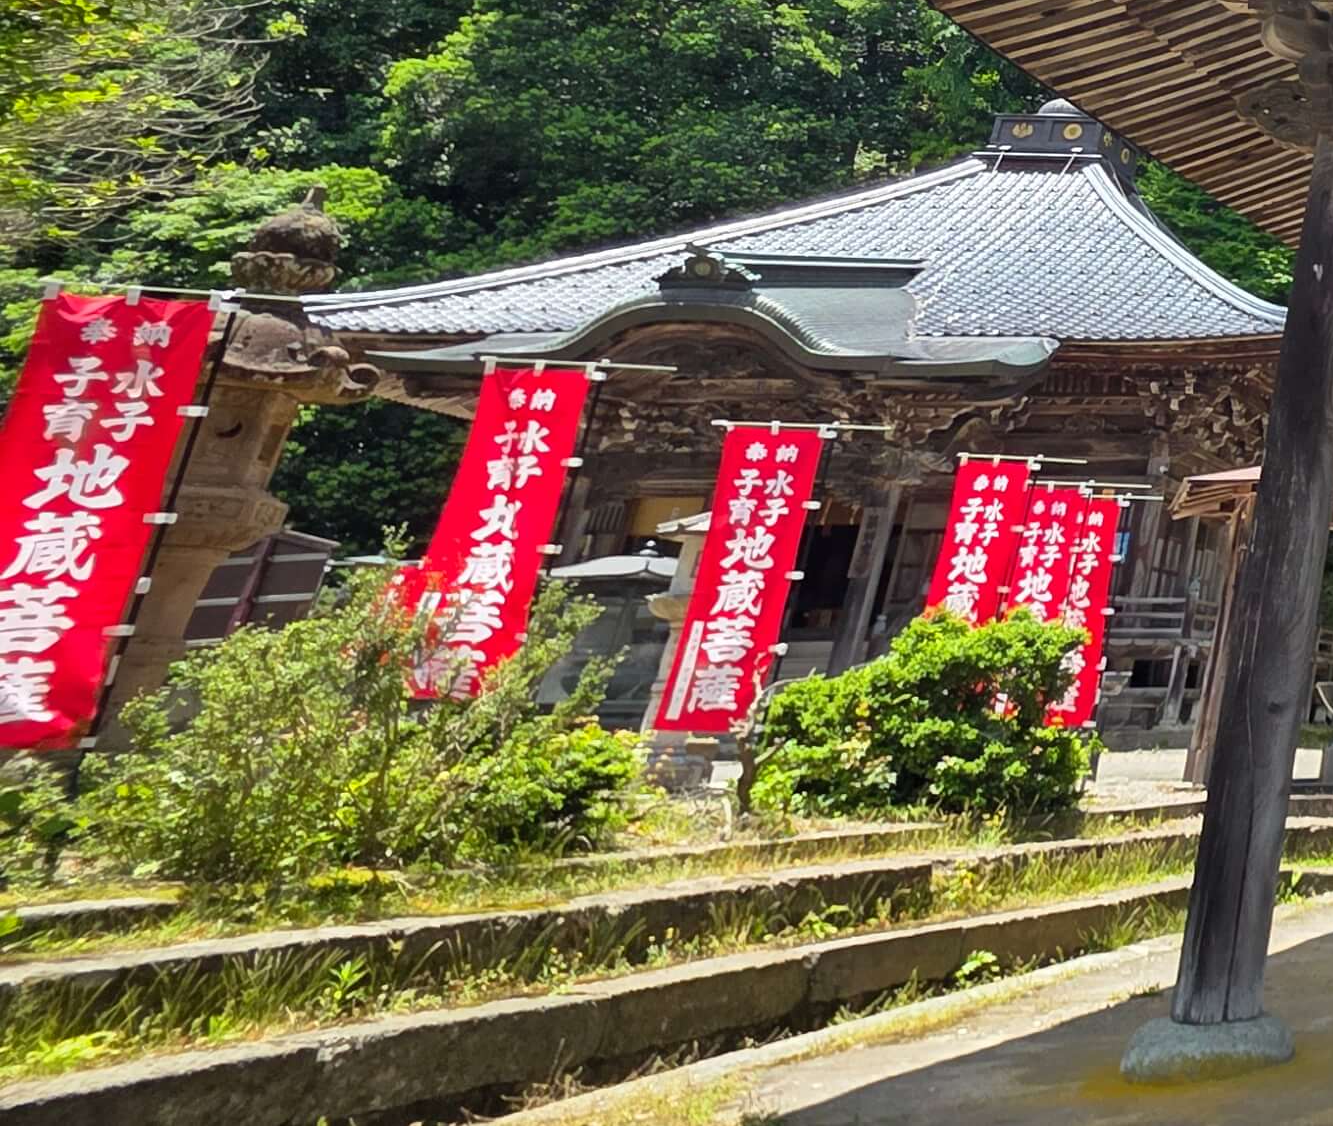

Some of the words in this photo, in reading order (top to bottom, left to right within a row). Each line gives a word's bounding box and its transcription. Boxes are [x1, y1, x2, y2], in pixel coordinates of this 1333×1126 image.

[80, 318, 174, 349] 奉納
[42, 356, 108, 443] 子育
[100, 358, 165, 442] 水子
[506, 387, 557, 412] 奉納
[744, 441, 800, 464] 奉納
[728, 468, 764, 527] 子育
[758, 469, 795, 528] 水子
[972, 473, 1009, 493] 奉納
[687, 526, 776, 714] 地蔵菩薩
